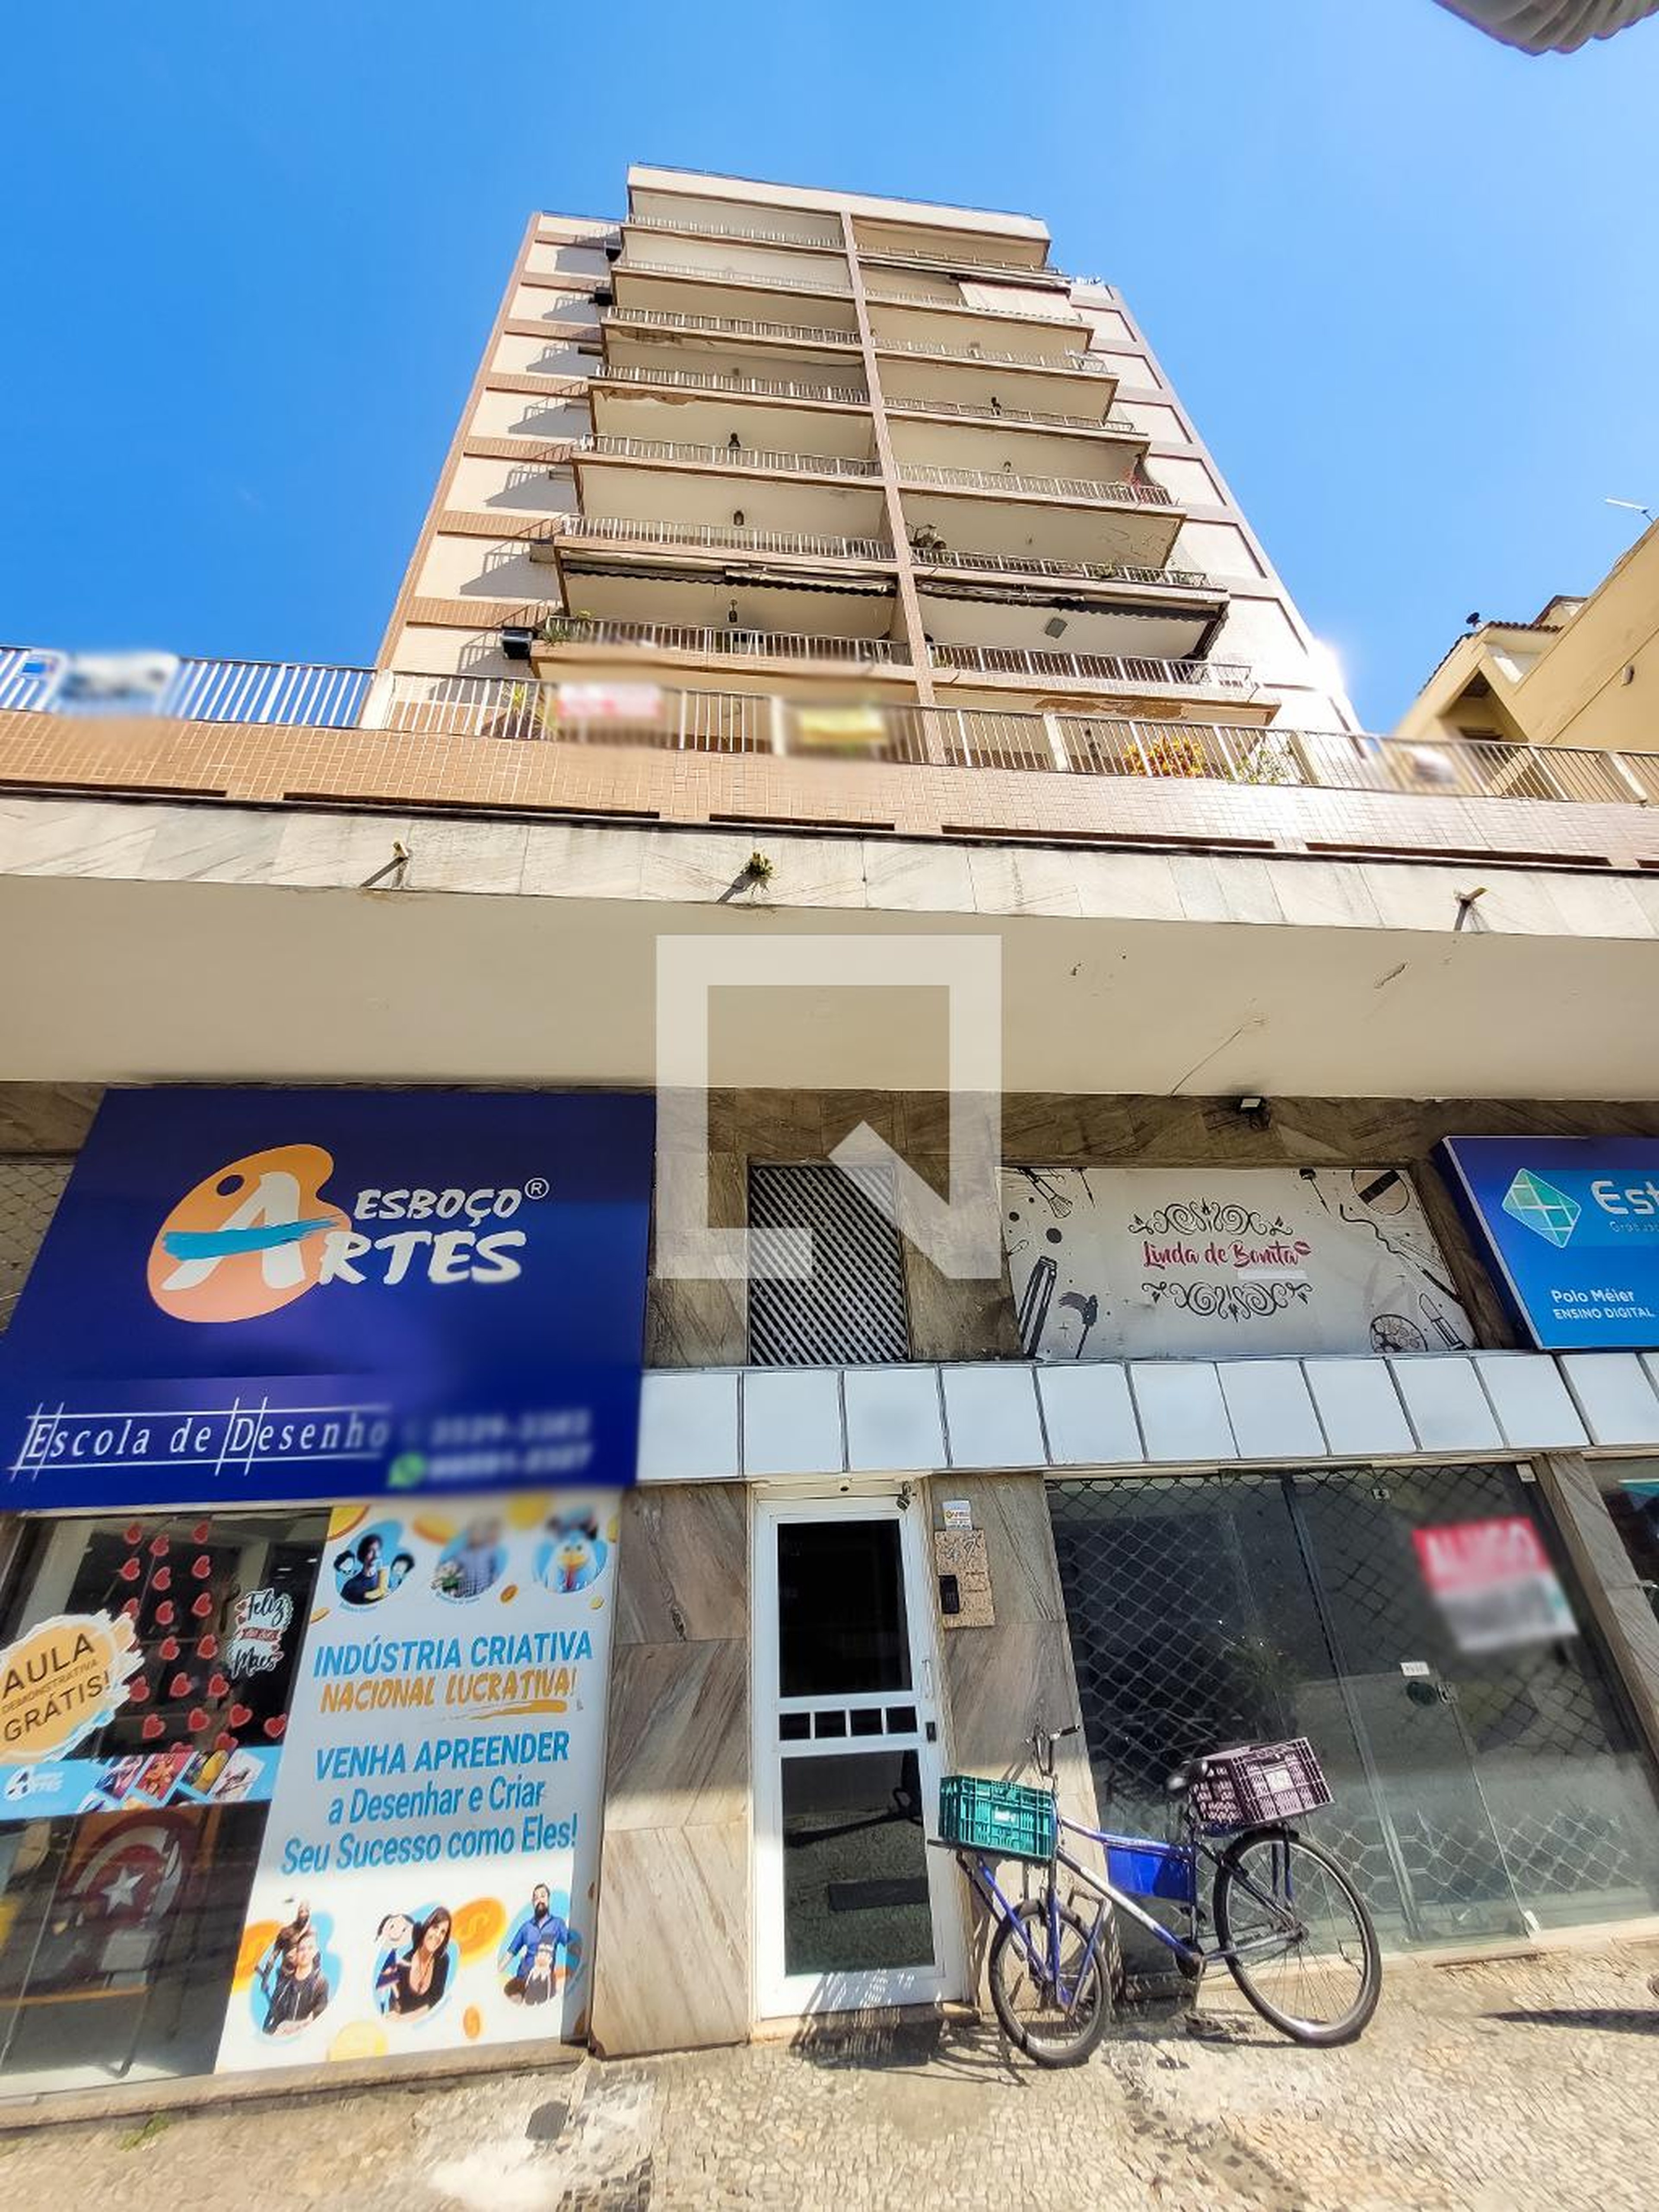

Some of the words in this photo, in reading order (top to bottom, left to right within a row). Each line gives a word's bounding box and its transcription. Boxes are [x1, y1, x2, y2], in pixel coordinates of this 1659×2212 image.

[162, 1171, 527, 1292] ARTES
[1144, 1241, 1200, 1270] Linda
[1205, 1241, 1229, 1266] de
[1229, 1239, 1298, 1268] Bonita
[1551, 1289, 1588, 1303] Polo
[1553, 1308, 1602, 1319] ENSINO
[1603, 1307, 1656, 1318] DIGITAL
[26, 1418, 149, 1460] Escola
[170, 1416, 211, 1453] de
[228, 1411, 391, 1453] Desenho
[2, 1633, 95, 1700] AULA
[313, 1634, 462, 1677] INDÚSTRIA
[470, 1630, 593, 1665] CRIATIVA
[4, 1671, 110, 1741] GRÁTIS!
[320, 1676, 435, 1713] NACIONAL
[445, 1668, 577, 1705] LUCRATIVA!
[316, 1743, 406, 1781] VENHA
[413, 1730, 570, 1773] APREENDER
[328, 1798, 343, 1825] a
[350, 1781, 464, 1824] Desenhar
[469, 1786, 483, 1813] e
[489, 1774, 546, 1810] Criar
[282, 1837, 330, 1876] Seu
[336, 1830, 442, 1870] Sucesso
[448, 1827, 515, 1860] como
[521, 1813, 578, 1852] Eles!
